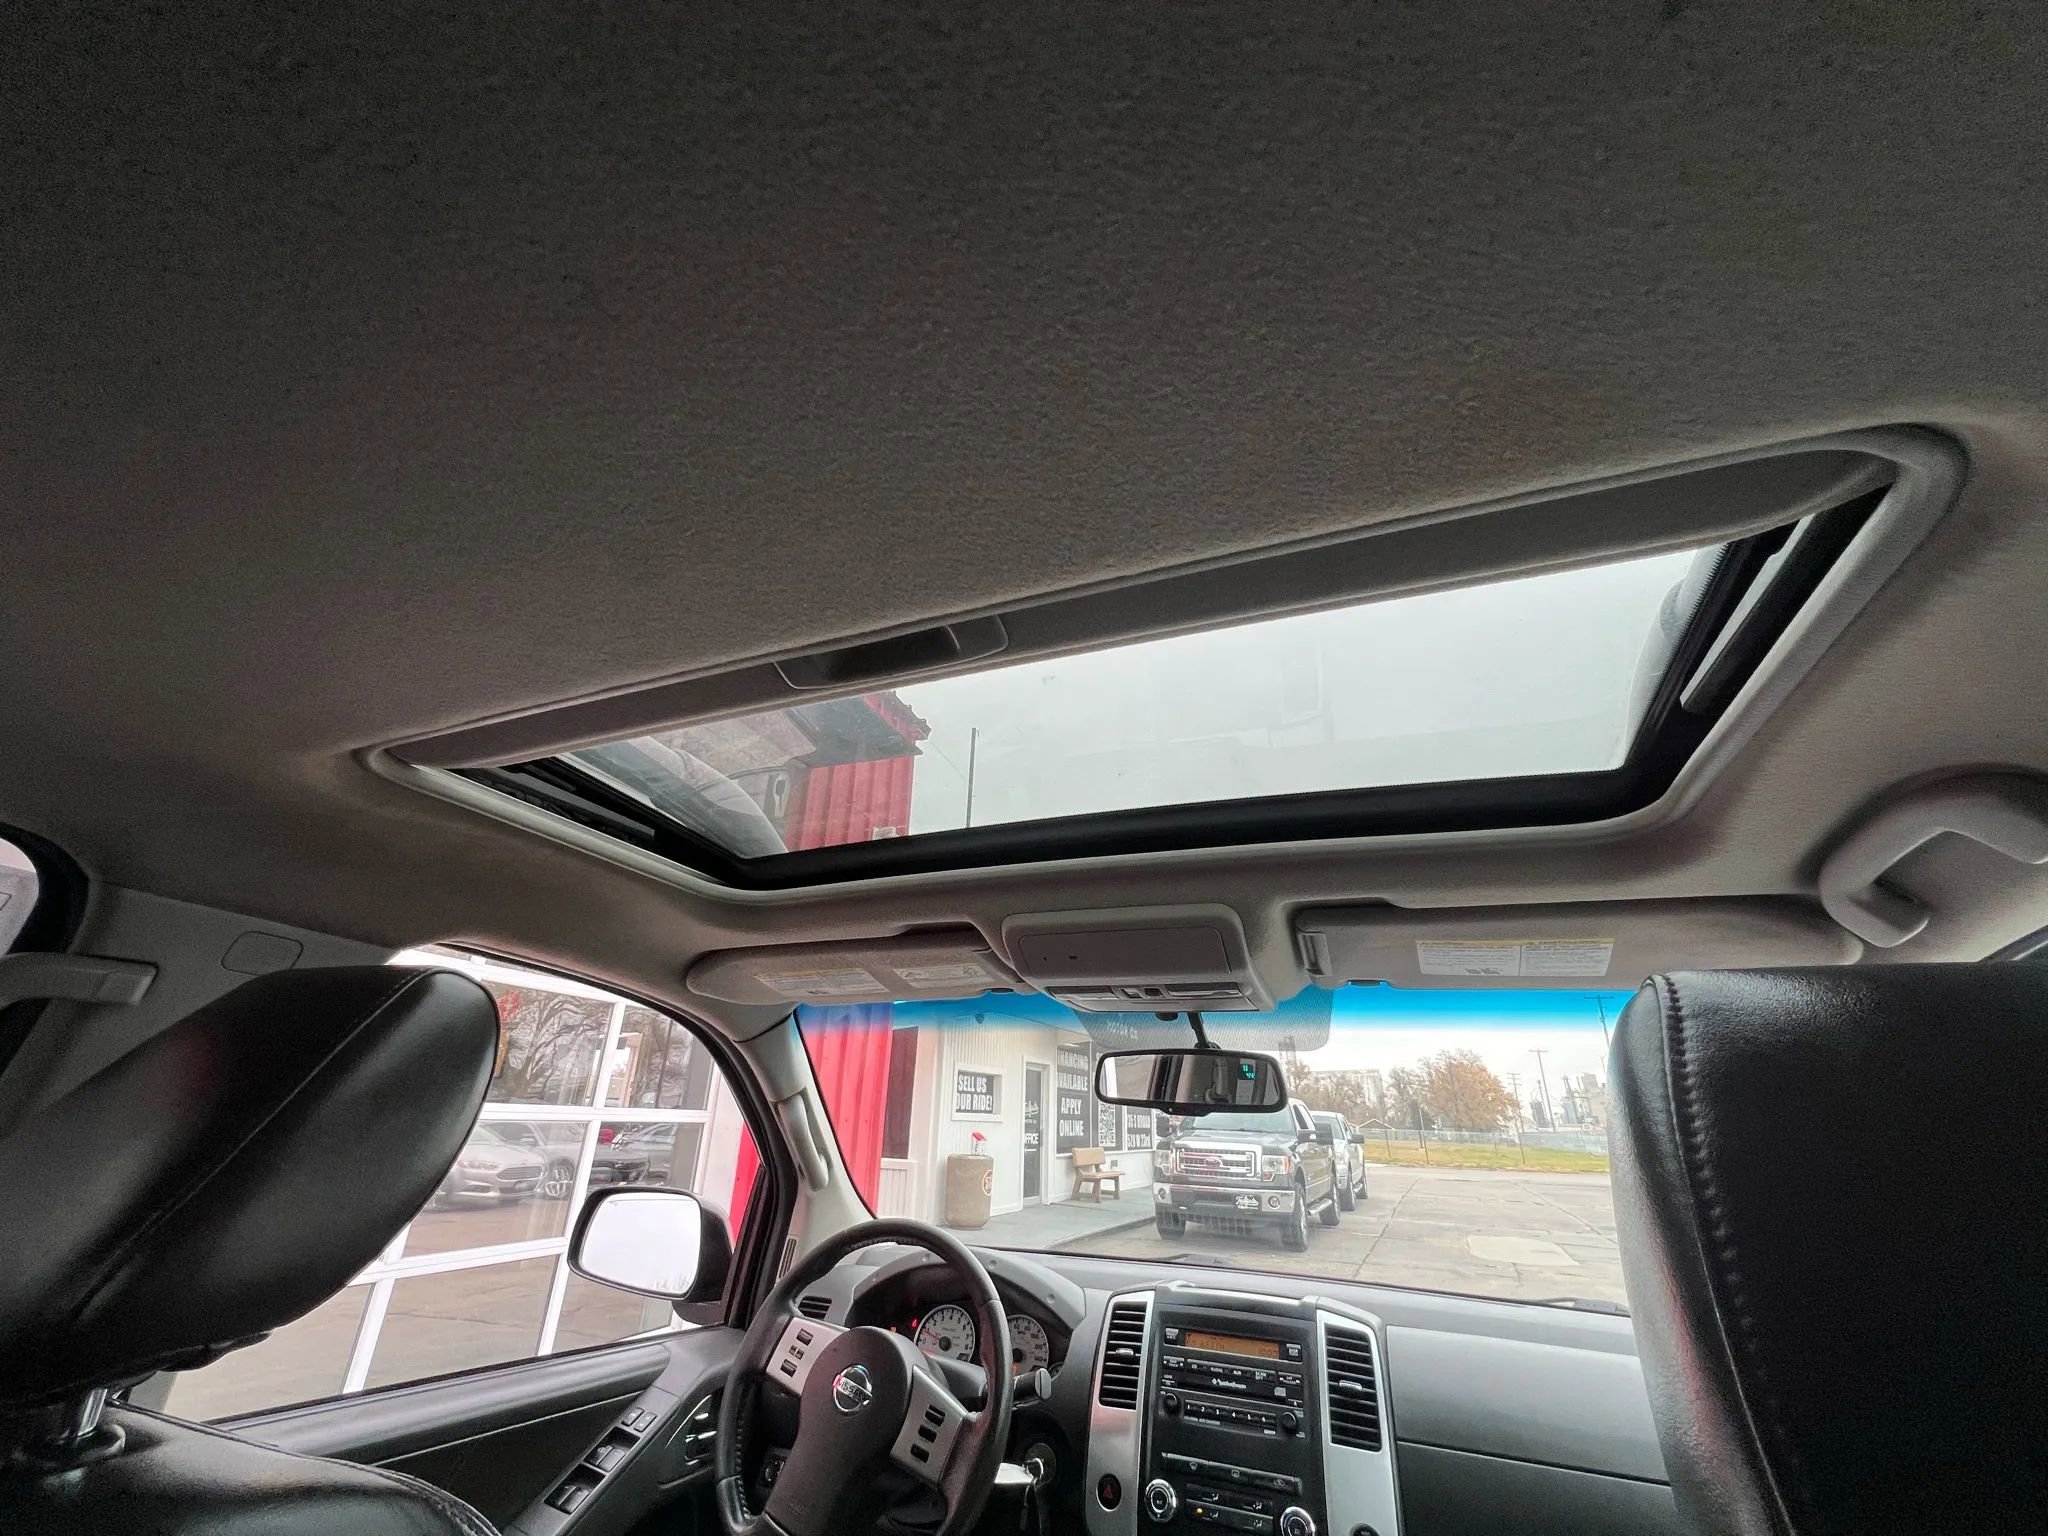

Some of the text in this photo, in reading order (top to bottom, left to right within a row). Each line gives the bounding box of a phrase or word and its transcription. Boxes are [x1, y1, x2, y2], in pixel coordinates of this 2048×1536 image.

[1057, 1050, 1088, 1070] INANCING
[958, 1075, 987, 1093] SELL US
[1057, 1072, 1088, 1091] VAILABLE
[956, 1093, 992, 1111] OUR RIDE!
[1061, 1097, 1081, 1115] APPLY
[1059, 1119, 1083, 1137] ONLINE
[1024, 1132, 1039, 1144] FFICE
